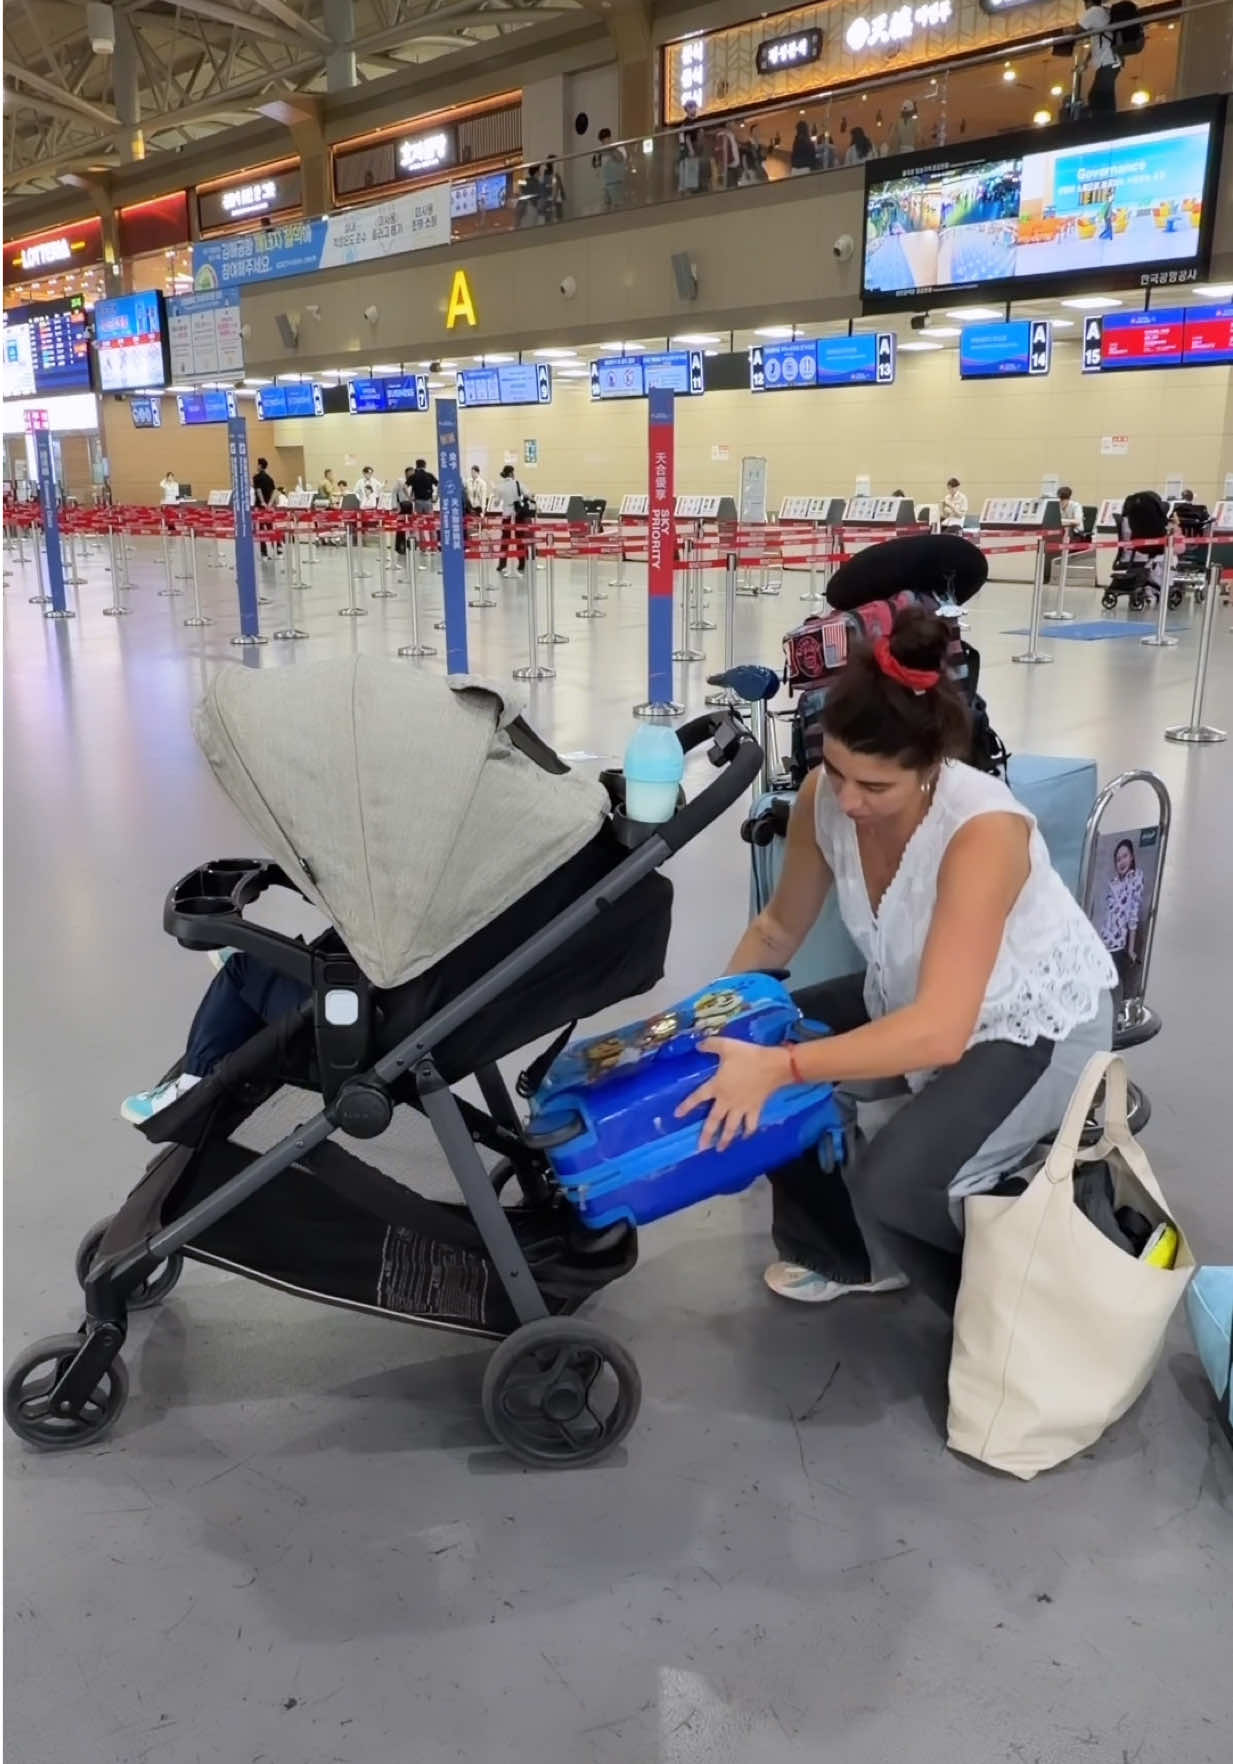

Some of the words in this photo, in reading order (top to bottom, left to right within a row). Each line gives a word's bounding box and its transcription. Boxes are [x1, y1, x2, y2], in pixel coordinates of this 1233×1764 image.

[1077, 160, 1147, 180] Governance
[446, 269, 477, 329] A
[1034, 325, 1046, 343] A
[1086, 321, 1101, 340] A
[880, 338, 890, 354] A
[692, 355, 700, 368] A
[753, 349, 763, 365] A
[1032, 352, 1046, 367] 14
[1085, 349, 1101, 365] 15
[880, 363, 891, 376] 13
[661, 508, 671, 536] SKY
[651, 508, 661, 569] PRIORITY
